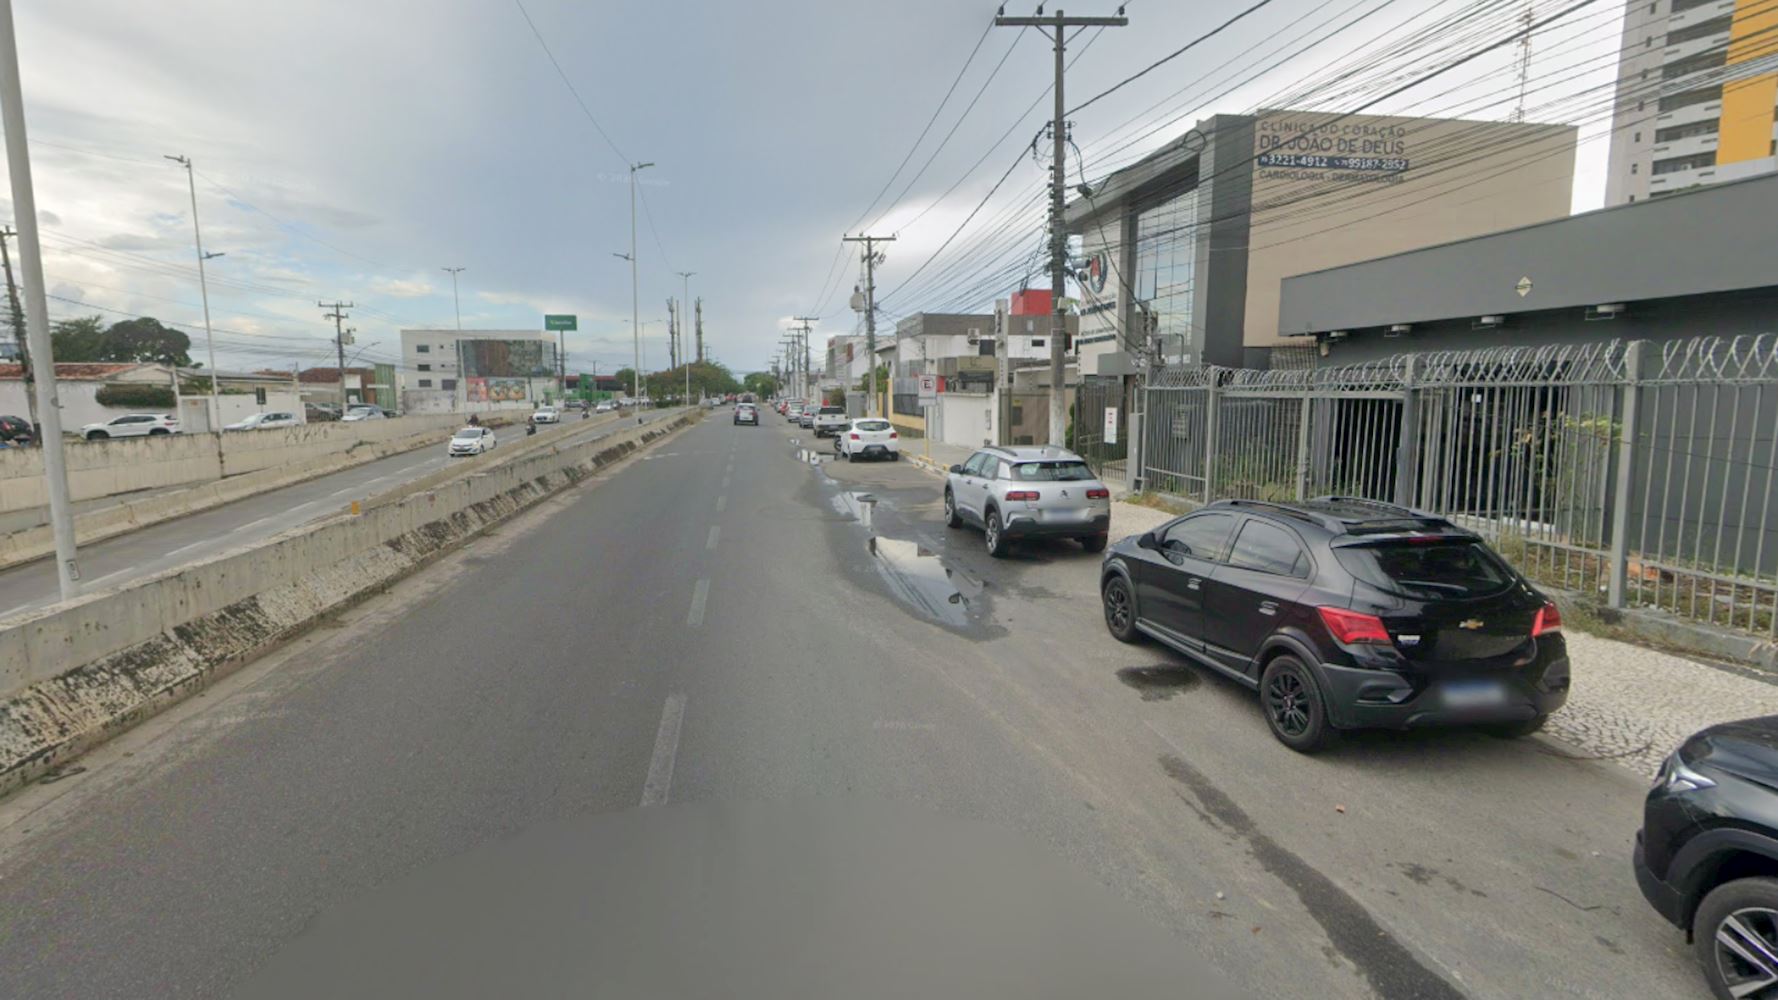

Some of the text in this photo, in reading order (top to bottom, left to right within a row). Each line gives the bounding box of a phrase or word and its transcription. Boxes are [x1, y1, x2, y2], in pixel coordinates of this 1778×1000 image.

[1287, 132, 1333, 151] JOÃO
[1337, 138, 1358, 152] DE
[1362, 139, 1405, 154] DEUS
